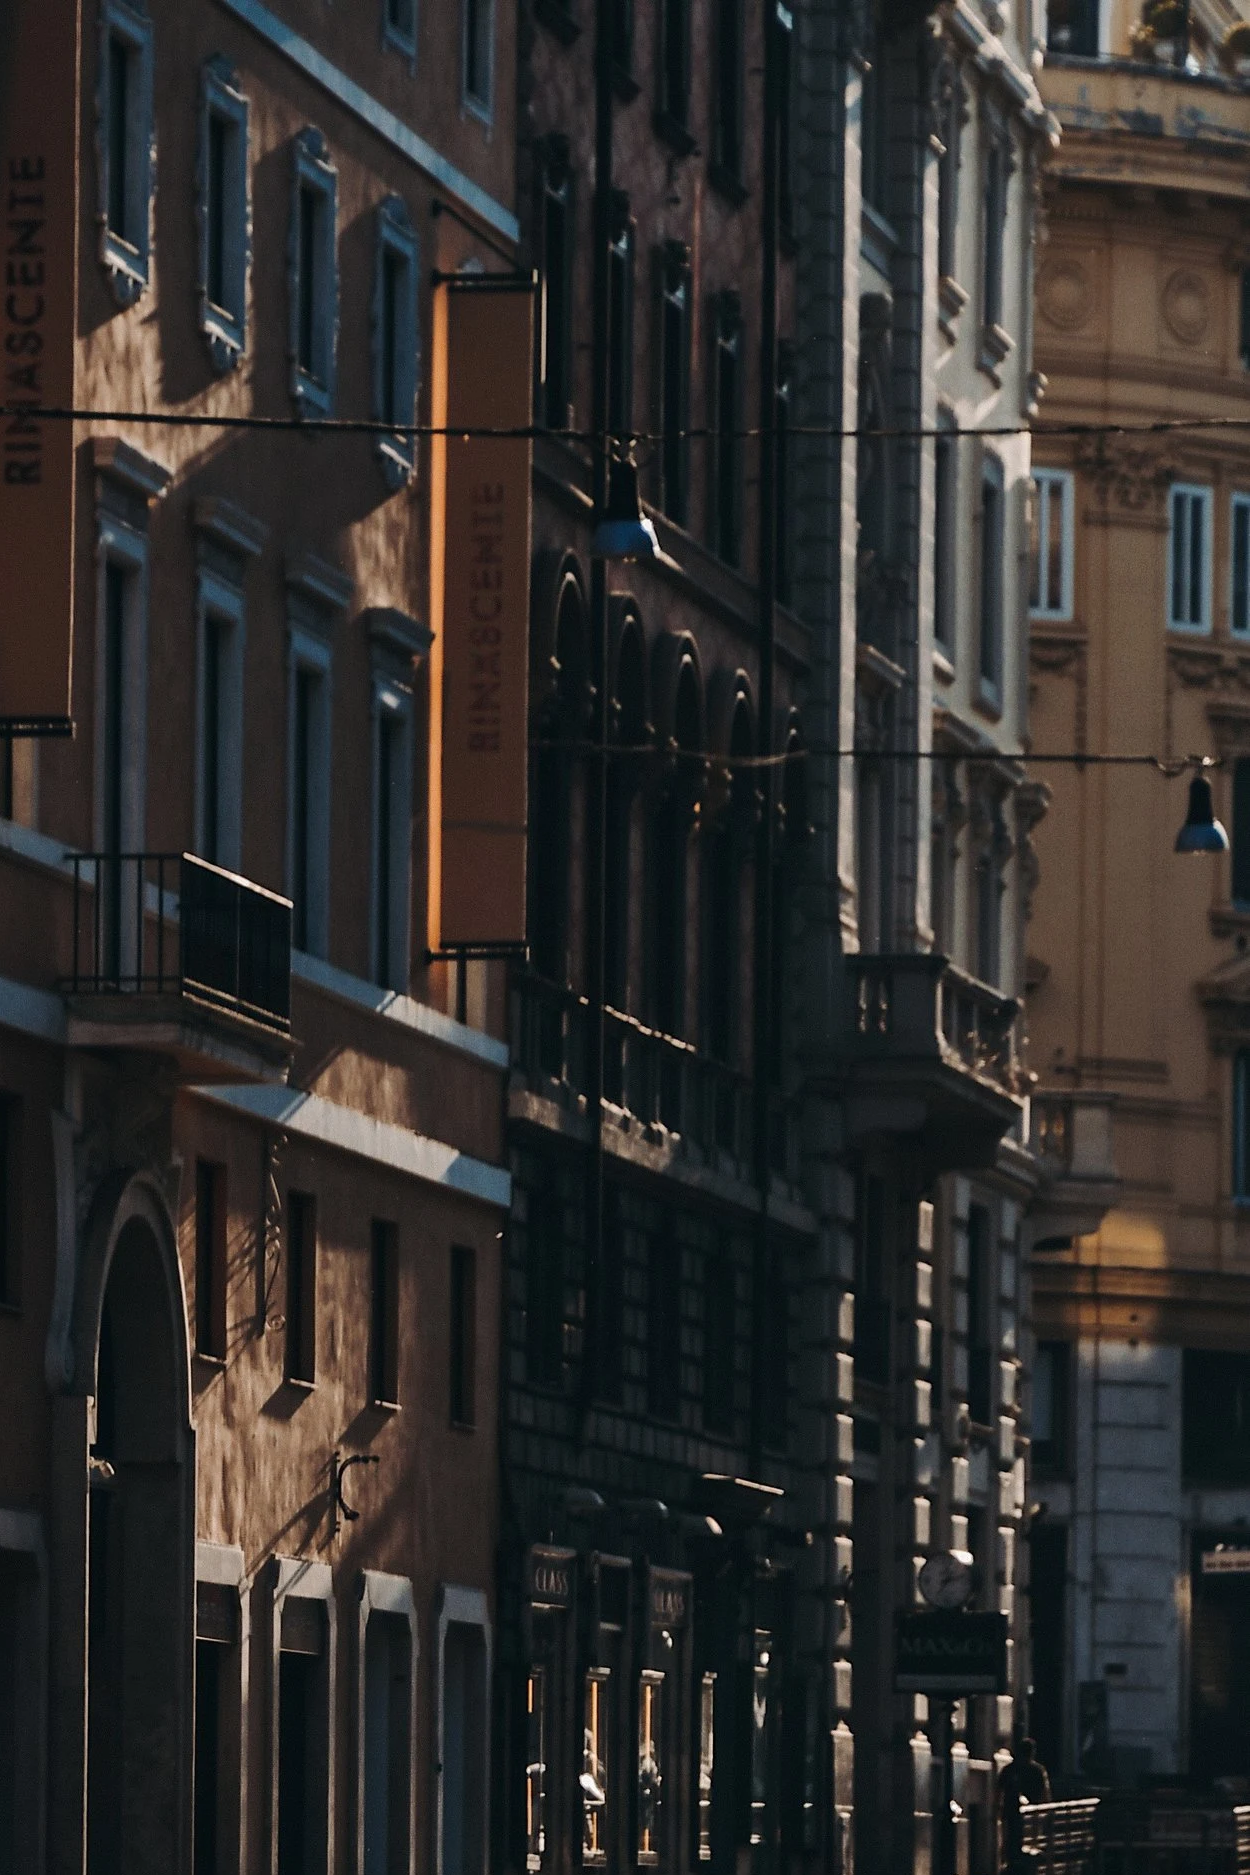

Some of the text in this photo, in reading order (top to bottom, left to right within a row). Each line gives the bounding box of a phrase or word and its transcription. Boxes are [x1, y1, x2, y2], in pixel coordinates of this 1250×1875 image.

[4, 154, 45, 486] RINASCENTE
[468, 482, 504, 752] RINASCENTE
[535, 1567, 569, 1596] CLASS
